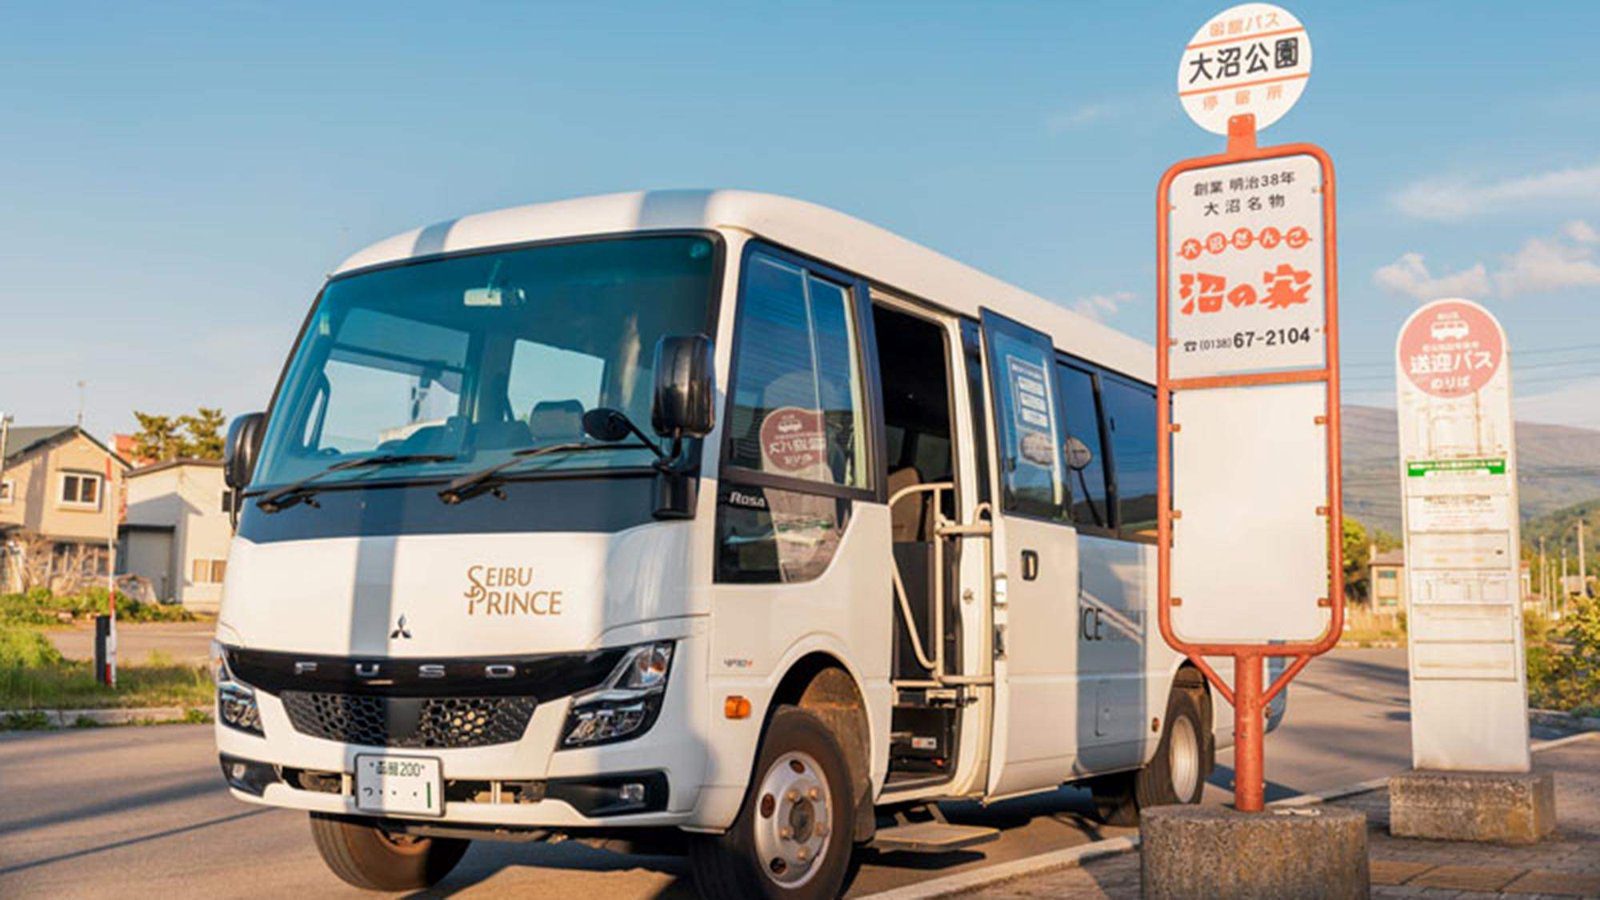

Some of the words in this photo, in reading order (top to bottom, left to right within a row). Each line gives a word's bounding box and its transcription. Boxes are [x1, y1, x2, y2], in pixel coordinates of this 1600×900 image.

[1188, 37, 1299, 84] 大沼公園
[1194, 180, 1224, 197] 創業
[1229, 171, 1296, 193] 明治38年
[1203, 194, 1286, 217] 大沼名物
[1410, 350, 1494, 374] 送迎バス
[464, 565, 534, 600] SEIBU
[464, 587, 562, 615] PRINCE
[294, 661, 517, 679] FUSO
